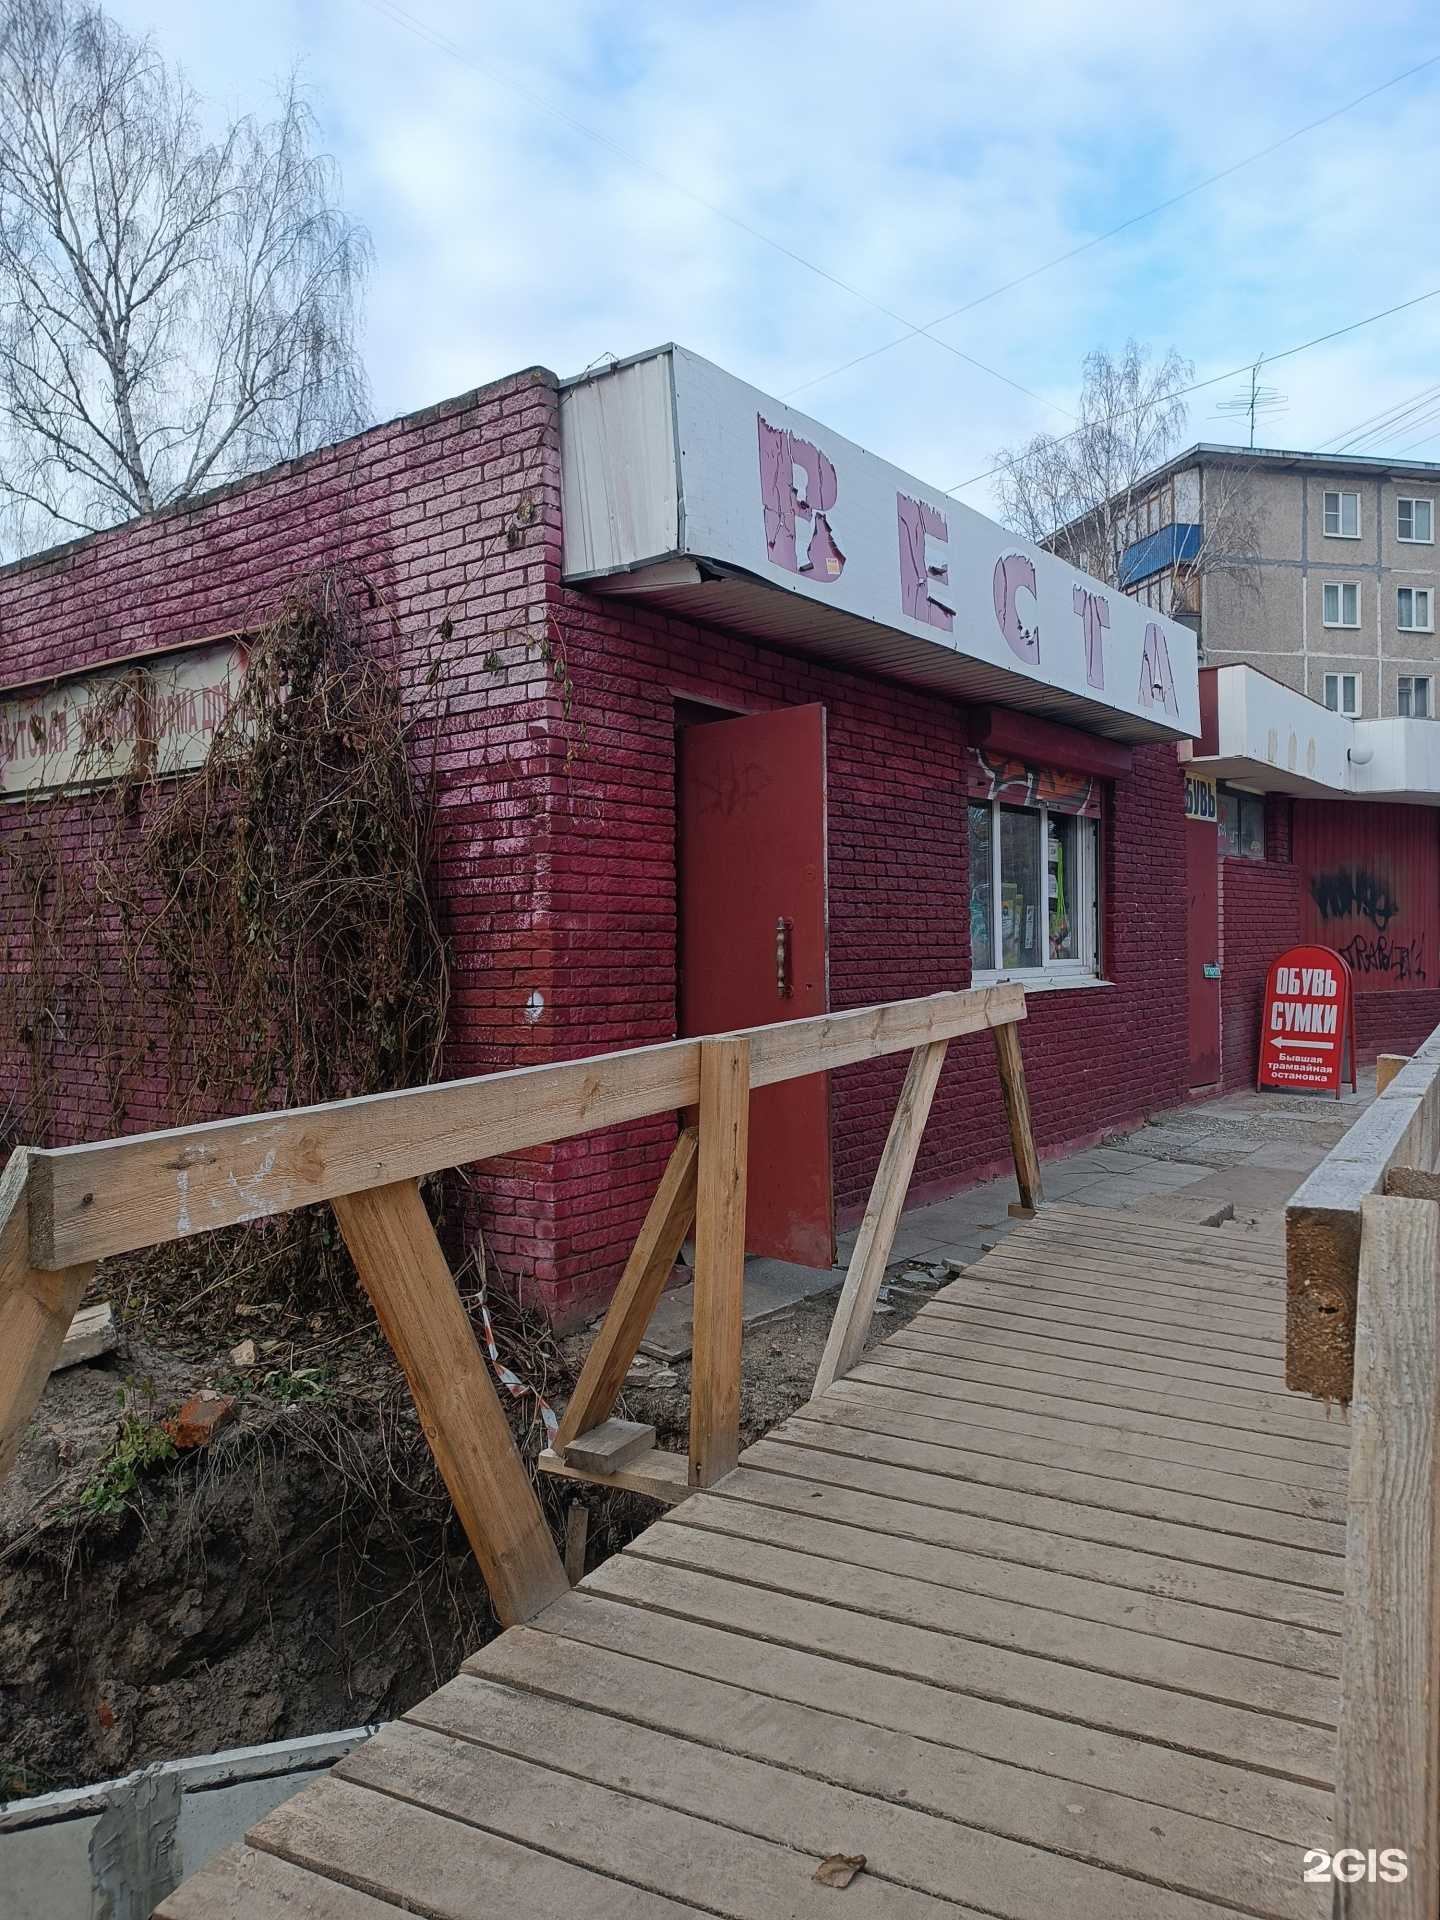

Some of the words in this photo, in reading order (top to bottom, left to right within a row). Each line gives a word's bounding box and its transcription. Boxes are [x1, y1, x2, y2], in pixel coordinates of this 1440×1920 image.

[758, 411, 1179, 718] ВЕСТА
[1184, 777, 1215, 817] БУВЬ
[1276, 967, 1337, 997] ОБУВЬ
[1271, 1001, 1338, 1034] СУМКИ
[1268, 1062, 1333, 1073] трамвайная
[1278, 1052, 1323, 1064] Бывшая
[1271, 1071, 1328, 1082] остановка
